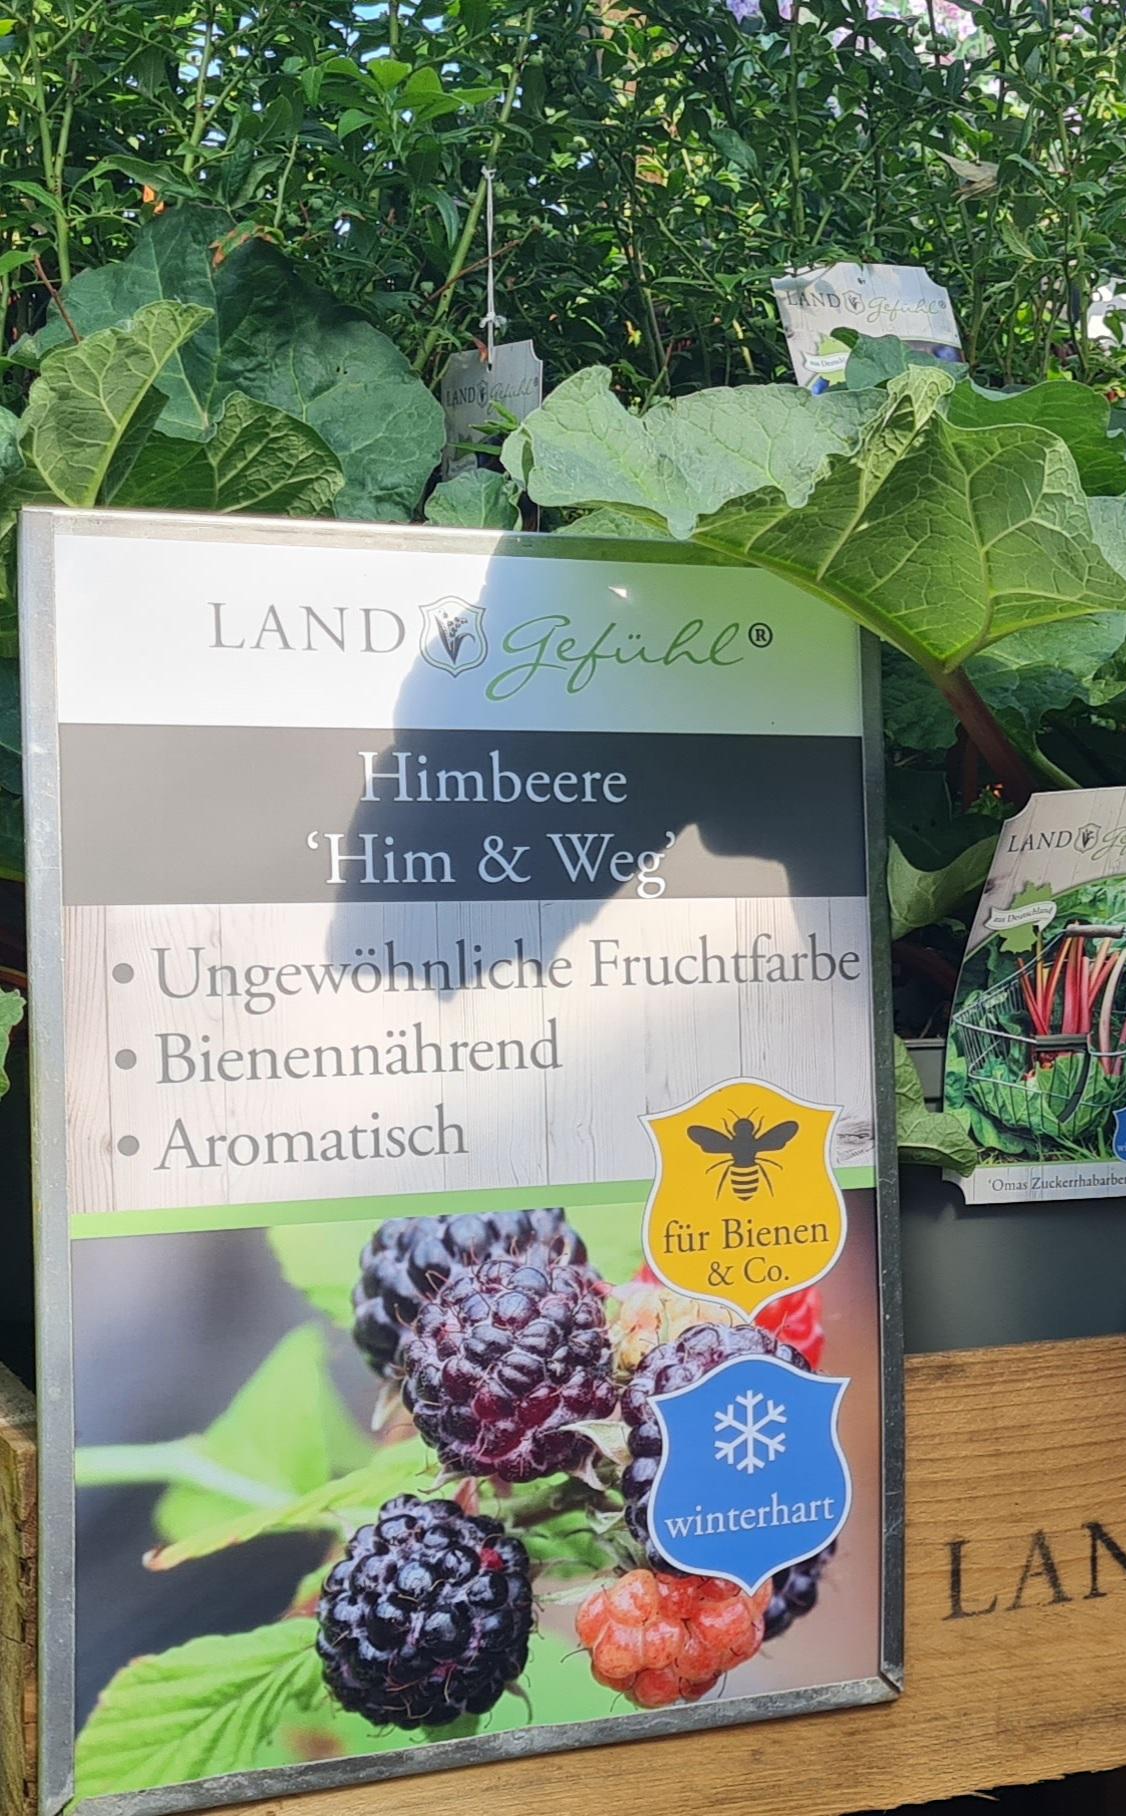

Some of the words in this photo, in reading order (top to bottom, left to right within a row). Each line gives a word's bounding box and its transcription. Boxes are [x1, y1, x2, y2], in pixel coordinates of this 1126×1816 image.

[786, 291, 841, 308] LAND
[446, 386, 476, 407] LAND
[207, 601, 407, 654] LAND
[357, 750, 628, 803] Himbeere
[477, 834, 532, 884] &
[1007, 829, 1073, 853] LAND
[1007, 905, 1054, 922] Deutschland
[151, 938, 574, 1016] Ungewöhnliche
[588, 932, 862, 988] Fruchtfarbe
[154, 1016, 563, 1085] Bienennährend
[152, 1102, 470, 1171] Aromatisch
[662, 1219, 710, 1254] für
[720, 1214, 830, 1251] Bienen
[706, 1260, 735, 1287] &
[742, 1256, 790, 1284] Co.
[663, 1492, 835, 1540] winterhart
